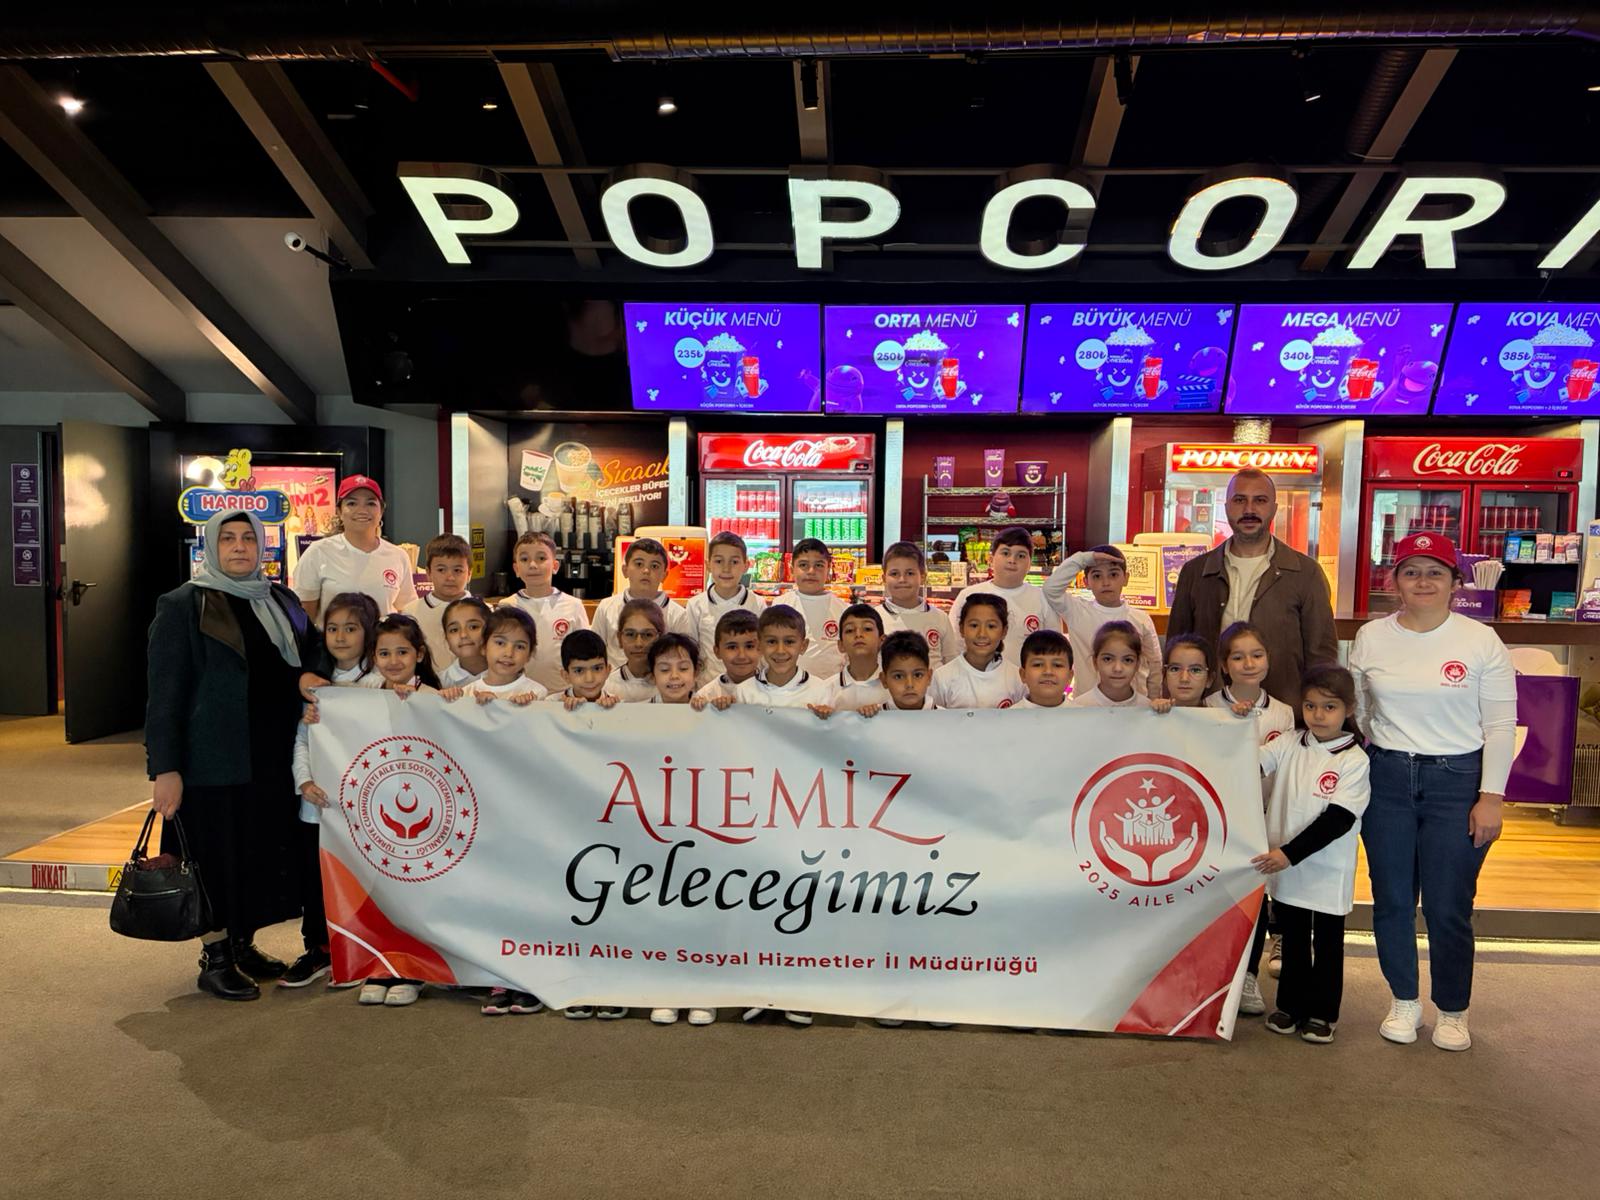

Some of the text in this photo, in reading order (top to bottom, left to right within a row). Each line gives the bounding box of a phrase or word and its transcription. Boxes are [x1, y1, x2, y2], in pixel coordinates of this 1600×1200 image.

[664, 307, 782, 330] KÜÇÜK MENÜ
[874, 310, 978, 329] ORTA MENÜ
[1072, 308, 1192, 327] BÜYÜK MENÜ
[1281, 309, 1401, 327] MEGA MENÜ
[1506, 311, 1560, 327] KOVA
[1180, 449, 1309, 467] POPCORN
[1413, 442, 1527, 475] Coca-Cola
[201, 495, 268, 511] HARIBO
[314, 487, 330, 507] 2
[379, 763, 395, 777] AİLE
[396, 762, 406, 770] VE
[408, 762, 436, 780] SOSYAL
[435, 778, 453, 825] HİZMETLER
[597, 755, 947, 845] AİLEMİZ
[416, 825, 450, 855] BAKANLIĞI
[565, 840, 982, 935] Geleceğimiz
[1079, 860, 1221, 907] 2025 AİLE YILI
[500, 939, 1038, 977] Denizli Aile ve Sosyal Hizmetler İl Müdürlüğü
